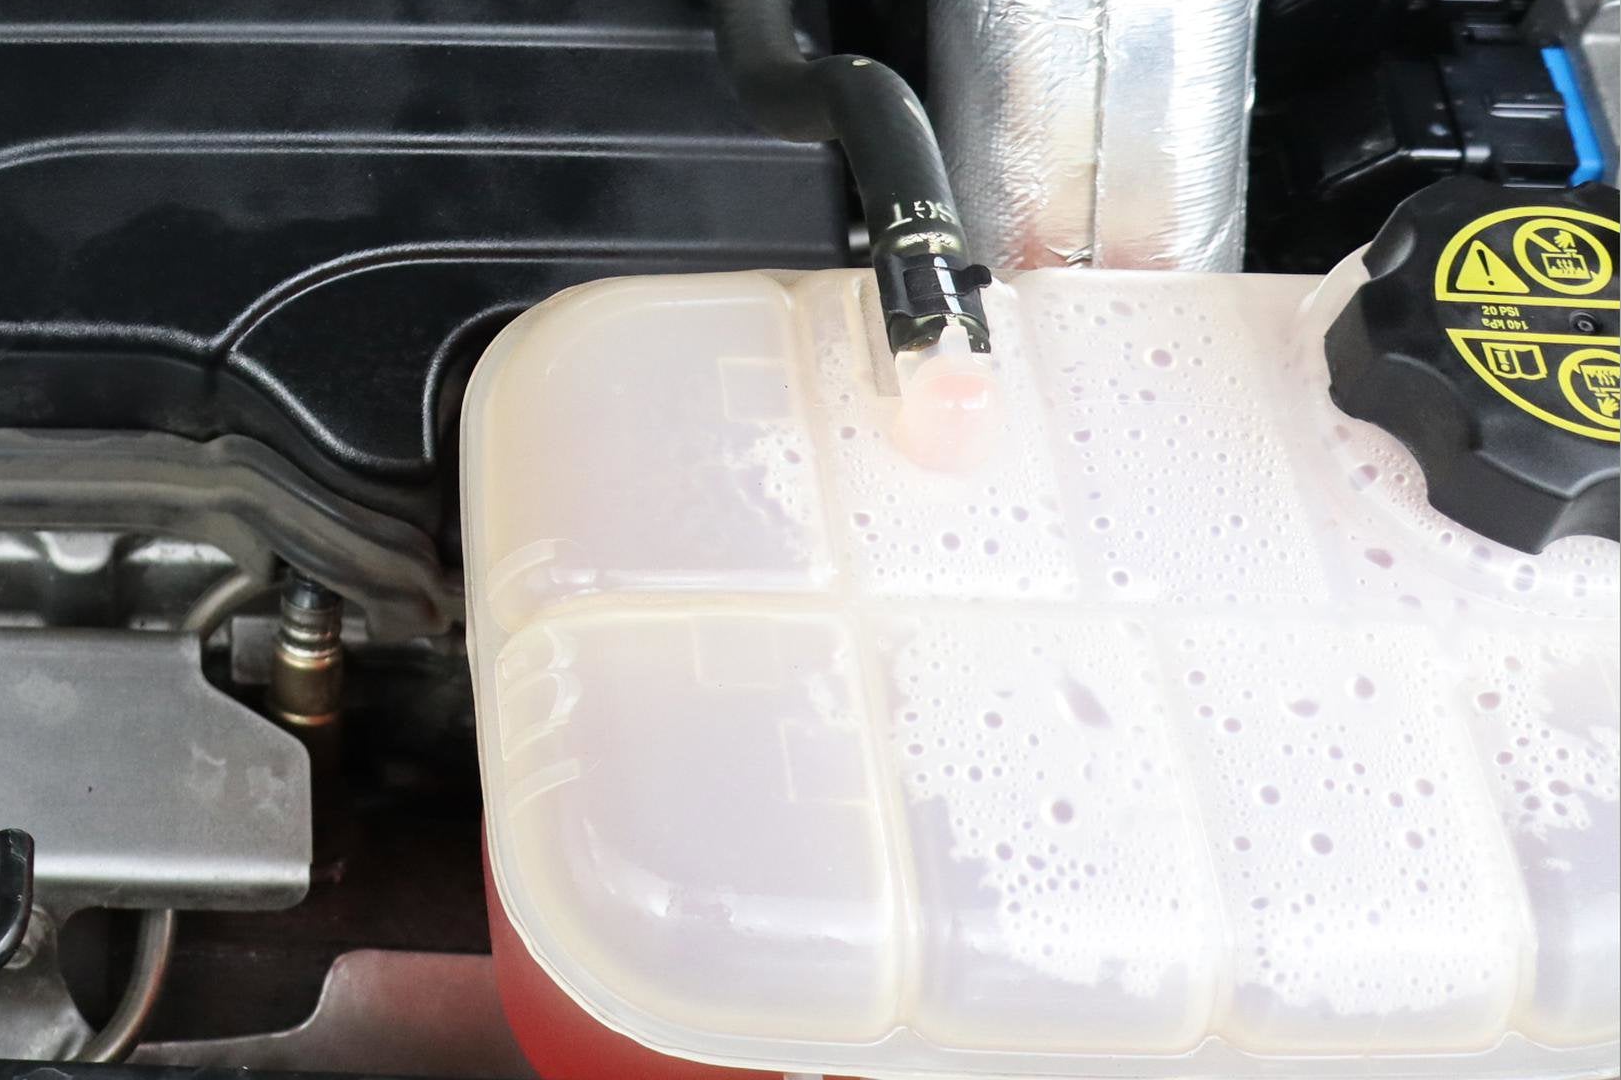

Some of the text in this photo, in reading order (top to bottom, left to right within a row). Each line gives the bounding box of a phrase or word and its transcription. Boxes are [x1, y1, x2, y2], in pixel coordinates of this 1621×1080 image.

[1481, 305, 1520, 318] 20 PSI
[1481, 317, 1529, 331] 140 kPa
